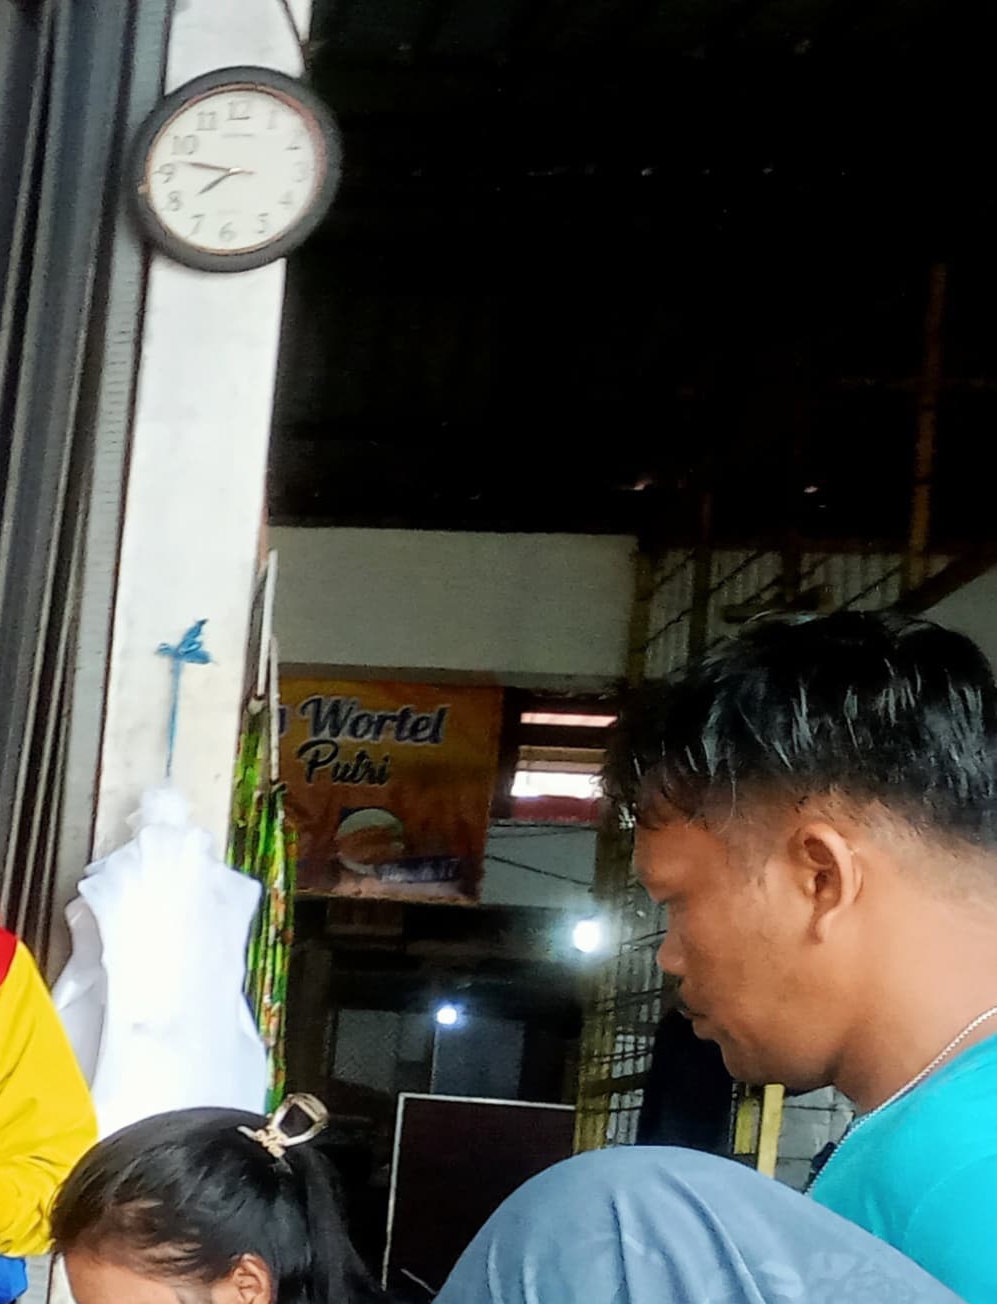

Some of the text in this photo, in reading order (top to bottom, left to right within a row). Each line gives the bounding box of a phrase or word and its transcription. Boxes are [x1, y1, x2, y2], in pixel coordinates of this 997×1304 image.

[196, 111, 217, 131] 11
[228, 101, 251, 120] 12
[171, 134, 200, 155] 10
[156, 163, 176, 184] 9
[167, 190, 183, 212] 8
[189, 213, 205, 237] 7
[218, 222, 235, 243] 6
[299, 693, 451, 745] Wortel
[297, 738, 392, 786] Putri
